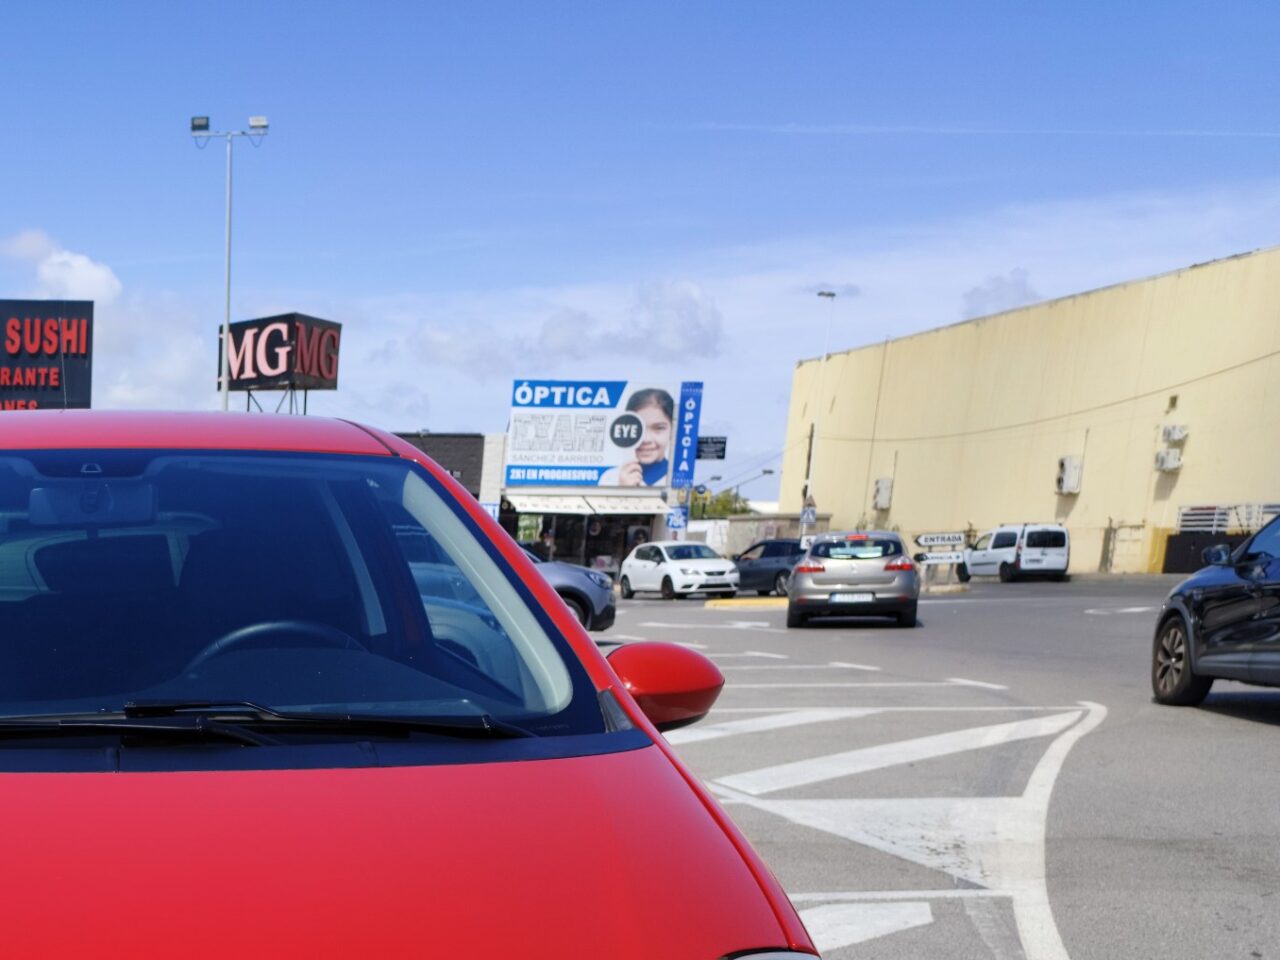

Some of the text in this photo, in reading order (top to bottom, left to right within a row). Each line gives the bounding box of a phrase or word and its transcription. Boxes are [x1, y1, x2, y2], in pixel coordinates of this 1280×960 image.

[5, 318, 87, 354] SUSHI
[219, 322, 292, 380] MG
[294, 321, 339, 380] MG
[515, 382, 611, 406] ÓPTICA
[614, 423, 638, 439] EYE
[679, 397, 696, 472] ÓPTICA
[527, 468, 538, 480] EN
[539, 468, 599, 481] PROGRESIVOS
[924, 534, 962, 543] ENTRADA
